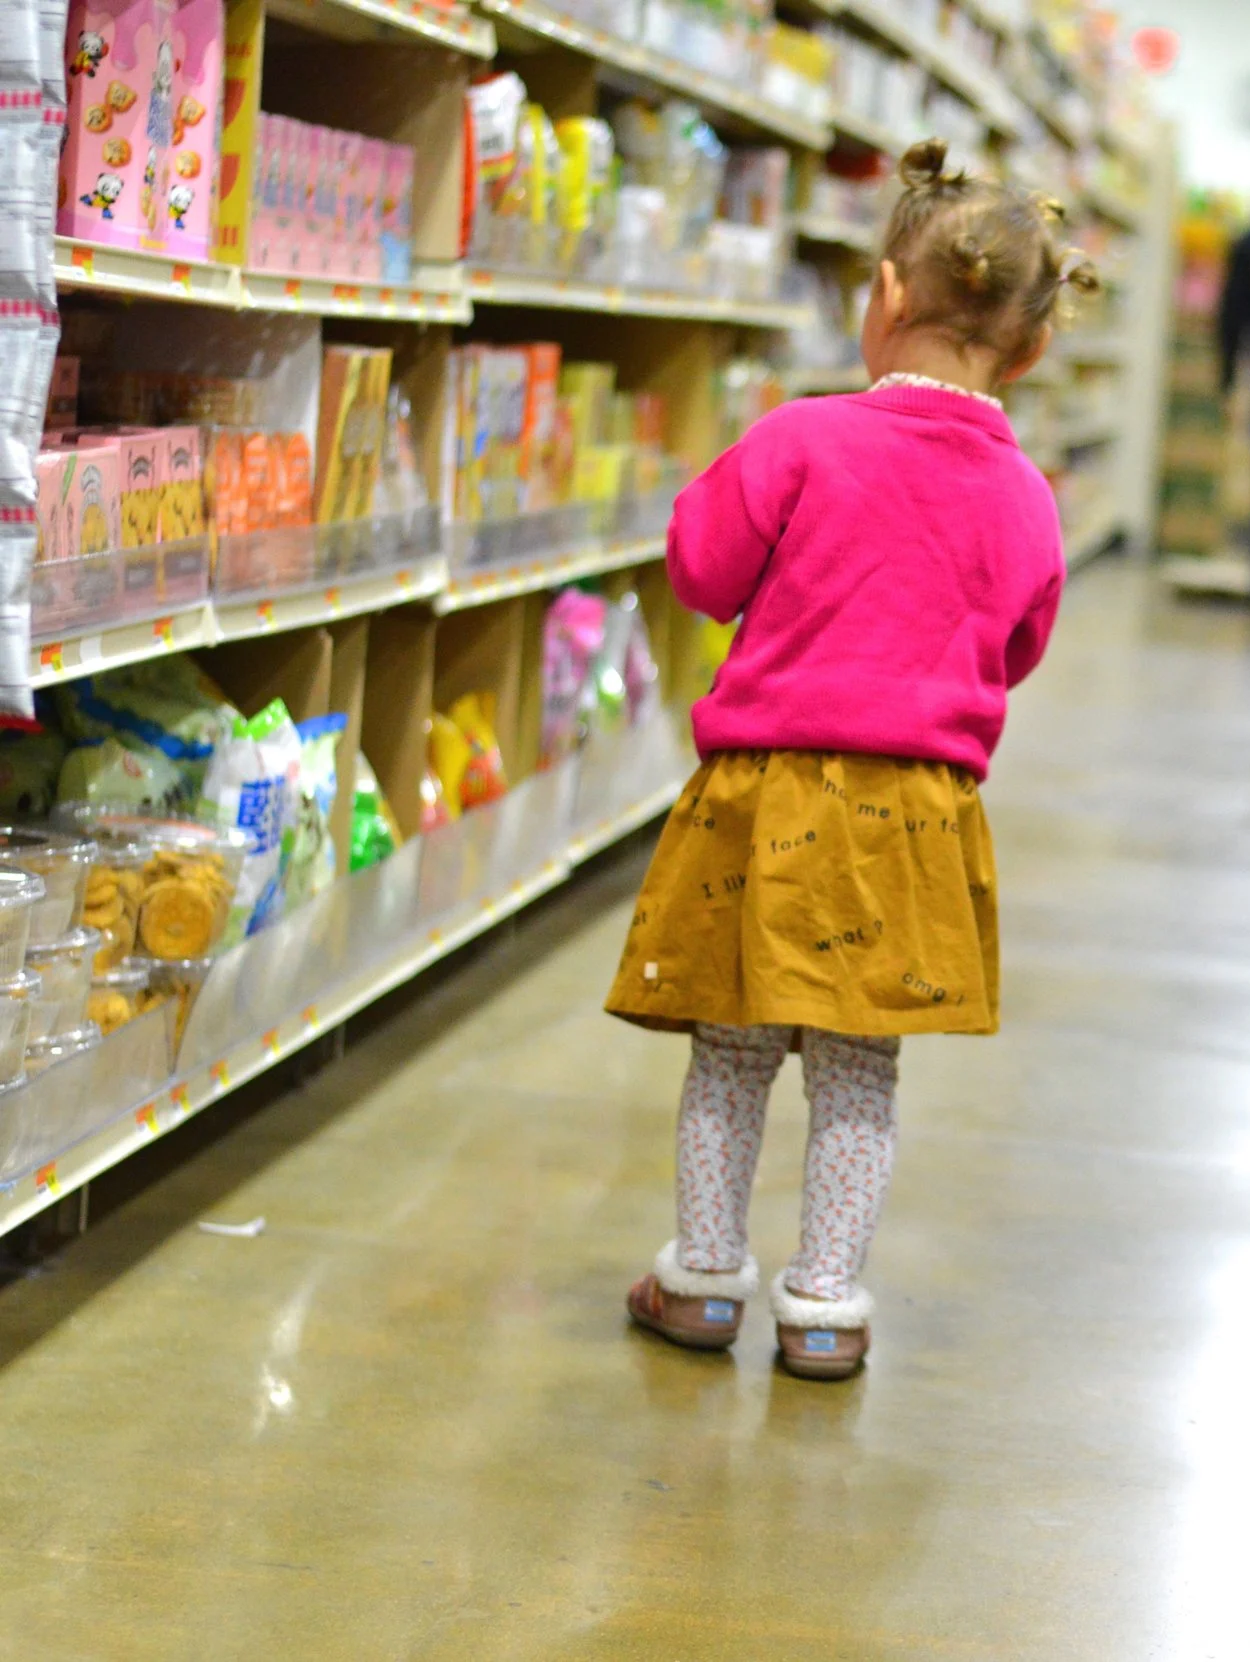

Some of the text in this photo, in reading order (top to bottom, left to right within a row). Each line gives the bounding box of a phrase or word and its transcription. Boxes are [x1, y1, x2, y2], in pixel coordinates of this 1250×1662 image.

[857, 803, 891, 820] me
[770, 829, 817, 855] face
[702, 882, 714, 899] I
[815, 927, 865, 952] what
[902, 972, 947, 1004] omg
